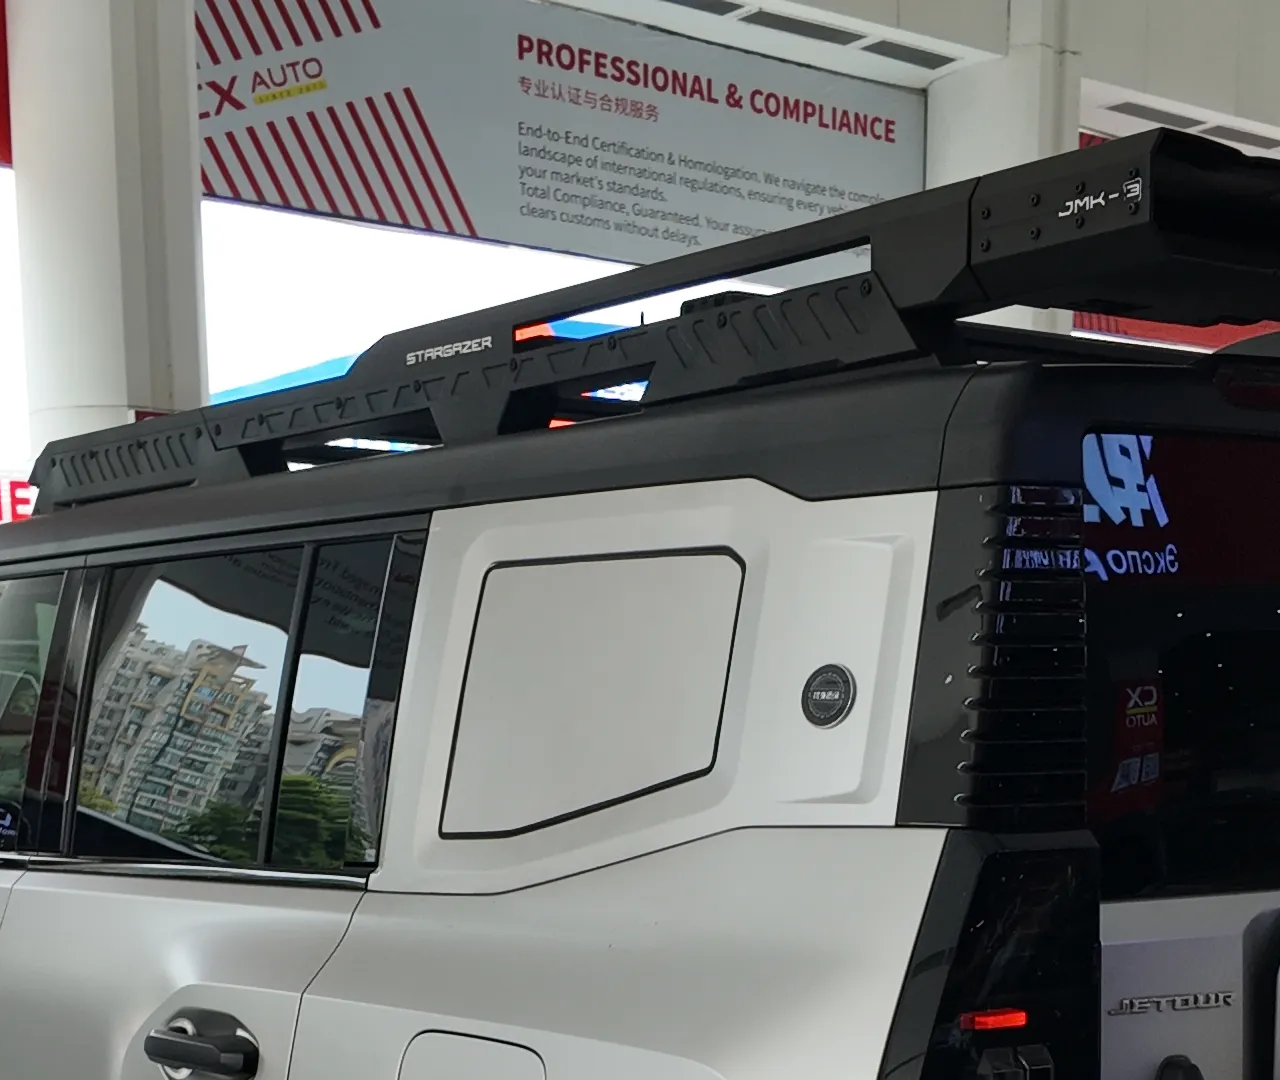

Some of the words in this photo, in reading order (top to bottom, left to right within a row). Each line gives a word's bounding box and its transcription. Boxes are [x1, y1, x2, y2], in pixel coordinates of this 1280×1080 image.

[197, 62, 247, 119] X
[252, 57, 324, 94] AUTO
[517, 33, 720, 105] PROFESSIONAL
[725, 82, 745, 111] &
[749, 87, 897, 145] COMPLIANCE
[518, 76, 661, 124] 专业认证与合规服务
[518, 121, 590, 148] End-to-End
[591, 137, 665, 163] Certification
[667, 152, 676, 166] &
[678, 155, 761, 184] Homologation.
[762, 170, 780, 188] We
[782, 176, 827, 196] navigate
[828, 184, 846, 200] the
[518, 141, 582, 167] landscape
[585, 155, 599, 170] of
[600, 160, 677, 184] international
[679, 175, 746, 200] regulations,
[747, 188, 795, 212] ensuring
[796, 199, 825, 217] every
[518, 164, 548, 180] your
[550, 169, 604, 191] market's
[606, 180, 668, 203] standards.
[519, 182, 551, 201] Total
[552, 188, 630, 216] Compliance,
[631, 204, 702, 229] Guaranteed.
[704, 215, 731, 231] Your
[519, 203, 557, 222] clears
[559, 209, 612, 231] customs
[613, 218, 660, 240] without
[661, 224, 702, 248] delays.
[406, 336, 493, 365] STARGAZER
[1108, 991, 1236, 1016] JETOUR
